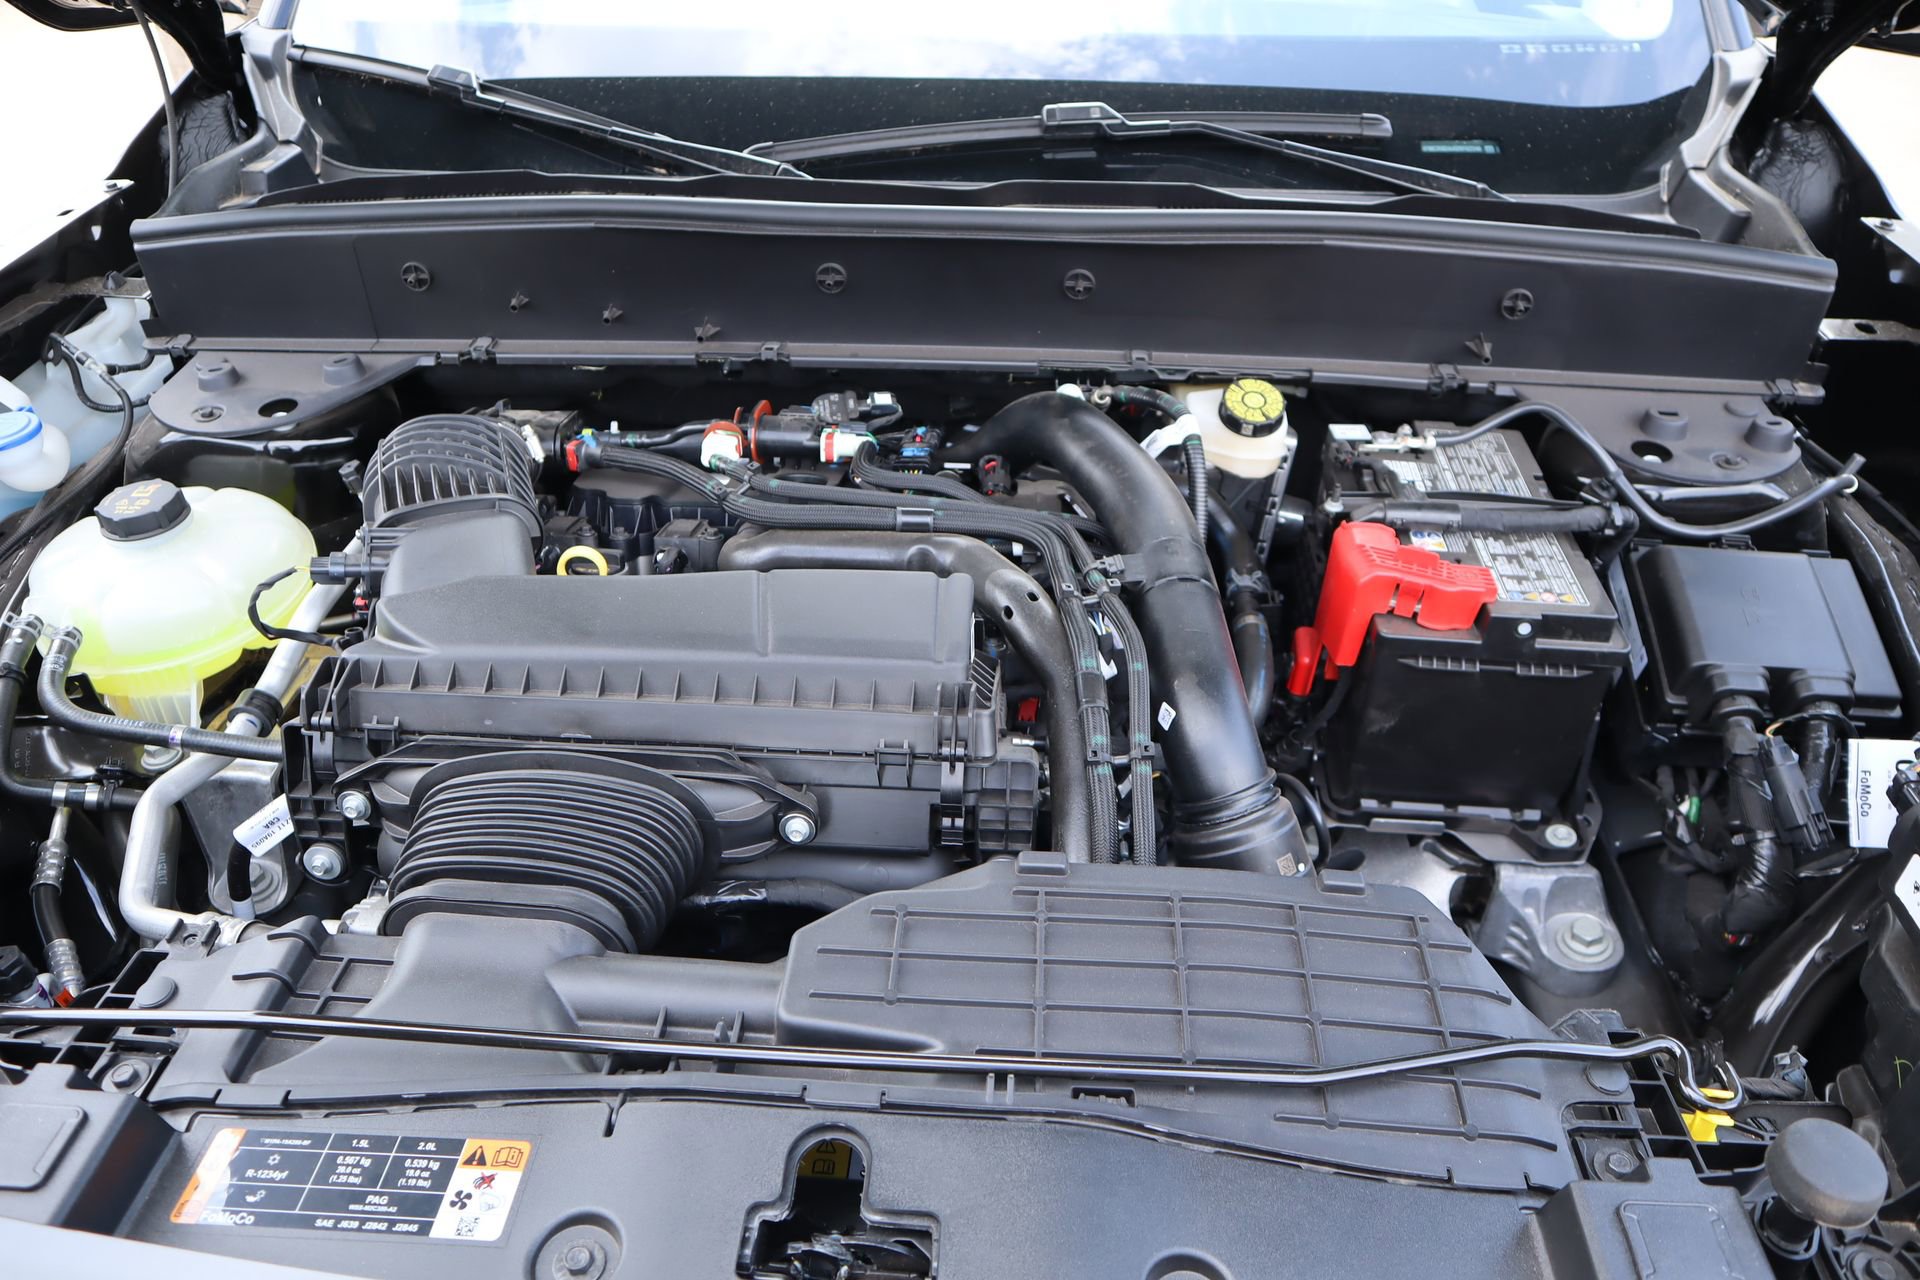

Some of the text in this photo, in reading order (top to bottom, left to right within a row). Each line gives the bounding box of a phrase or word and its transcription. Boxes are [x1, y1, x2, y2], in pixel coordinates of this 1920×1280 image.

[1860, 770, 1872, 818] FoMoCo
[263, 816, 280, 829] CBA
[352, 1139, 370, 1148] 1.5L
[417, 1142, 437, 1151] 2.0L
[359, 1157, 372, 1168] kg
[404, 1159, 441, 1170] 0.539 kg
[245, 1168, 289, 1180] R-1234yf
[365, 1195, 389, 1204] PAG
[200, 1210, 256, 1226] FoMoCo
[314, 1218, 335, 1228] SAE
